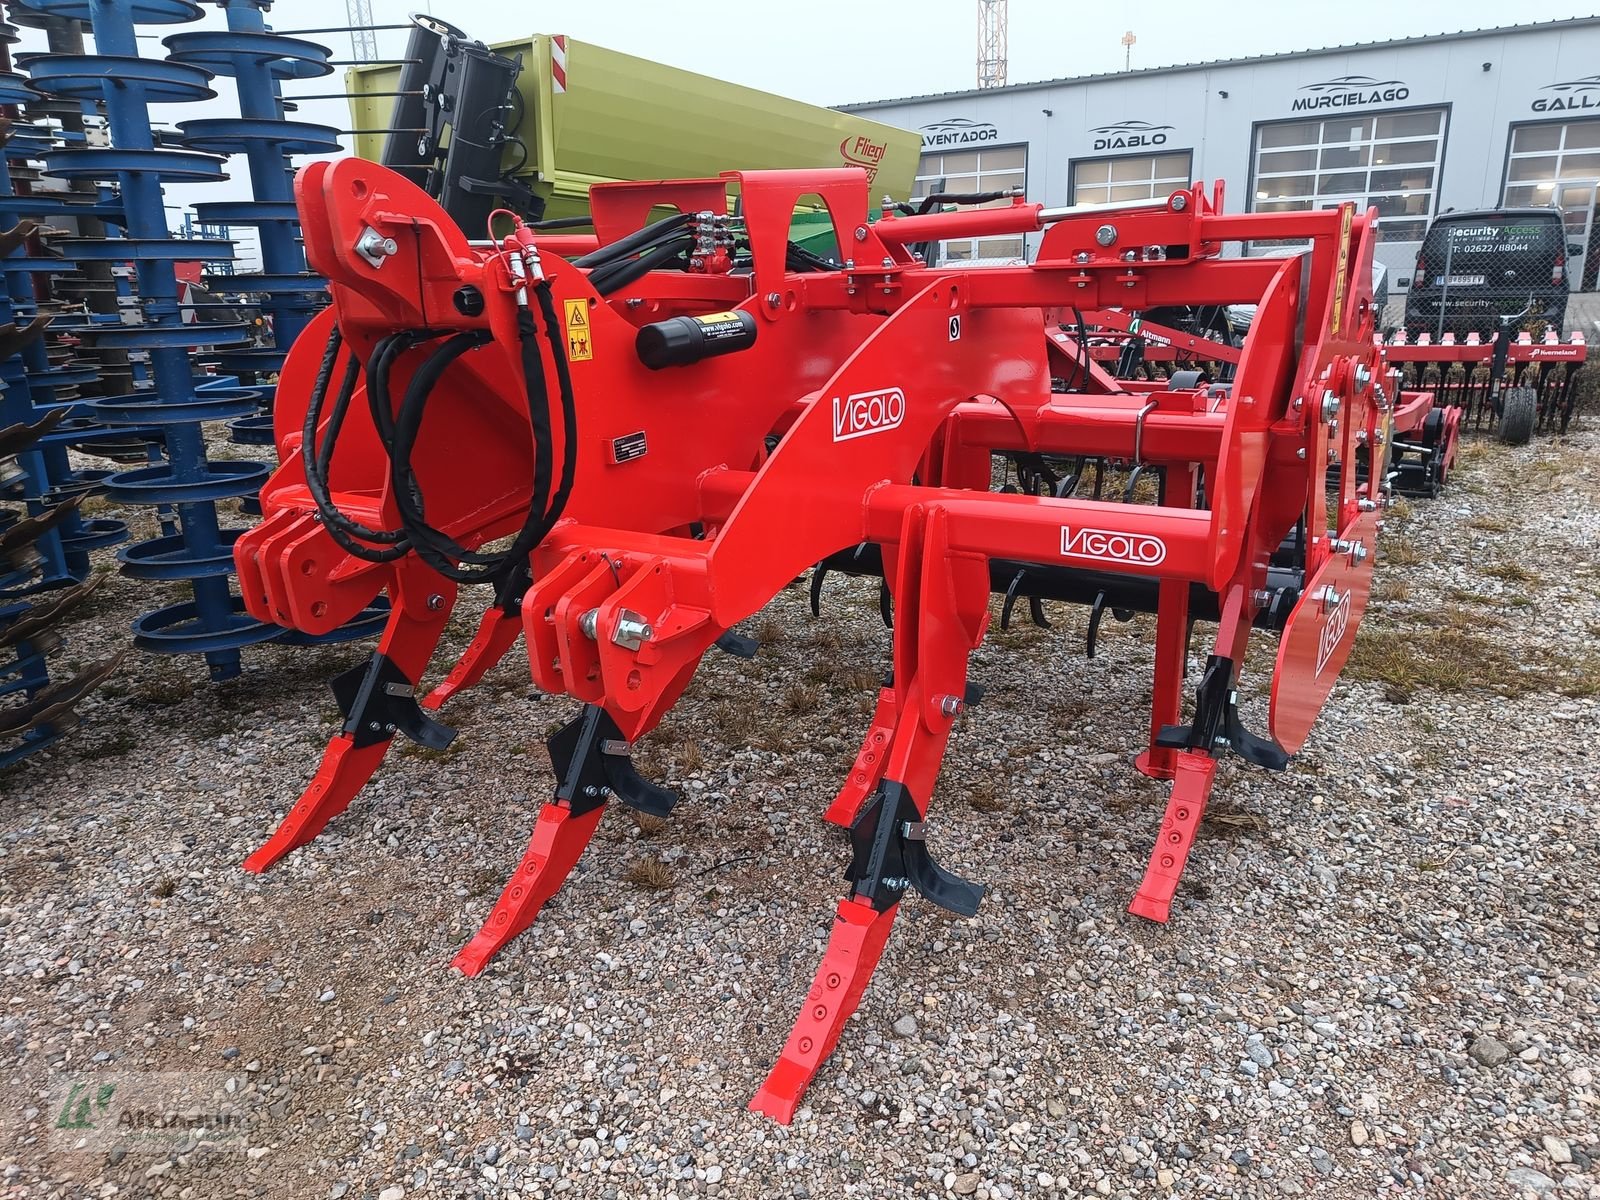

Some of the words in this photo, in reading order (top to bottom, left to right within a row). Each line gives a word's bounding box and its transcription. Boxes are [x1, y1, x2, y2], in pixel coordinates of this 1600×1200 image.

[1291, 88, 1410, 111] MURCIELAGO
[853, 136, 888, 162] Fliegl
[1094, 133, 1167, 150] DIABLO
[1448, 226, 1500, 237] Security
[1503, 226, 1541, 235] Access
[1140, 329, 1171, 345] Altmann
[833, 387, 906, 443] VIGOLO
[1060, 525, 1167, 567] VIGOLO
[1315, 589, 1351, 679] VIGOLO
